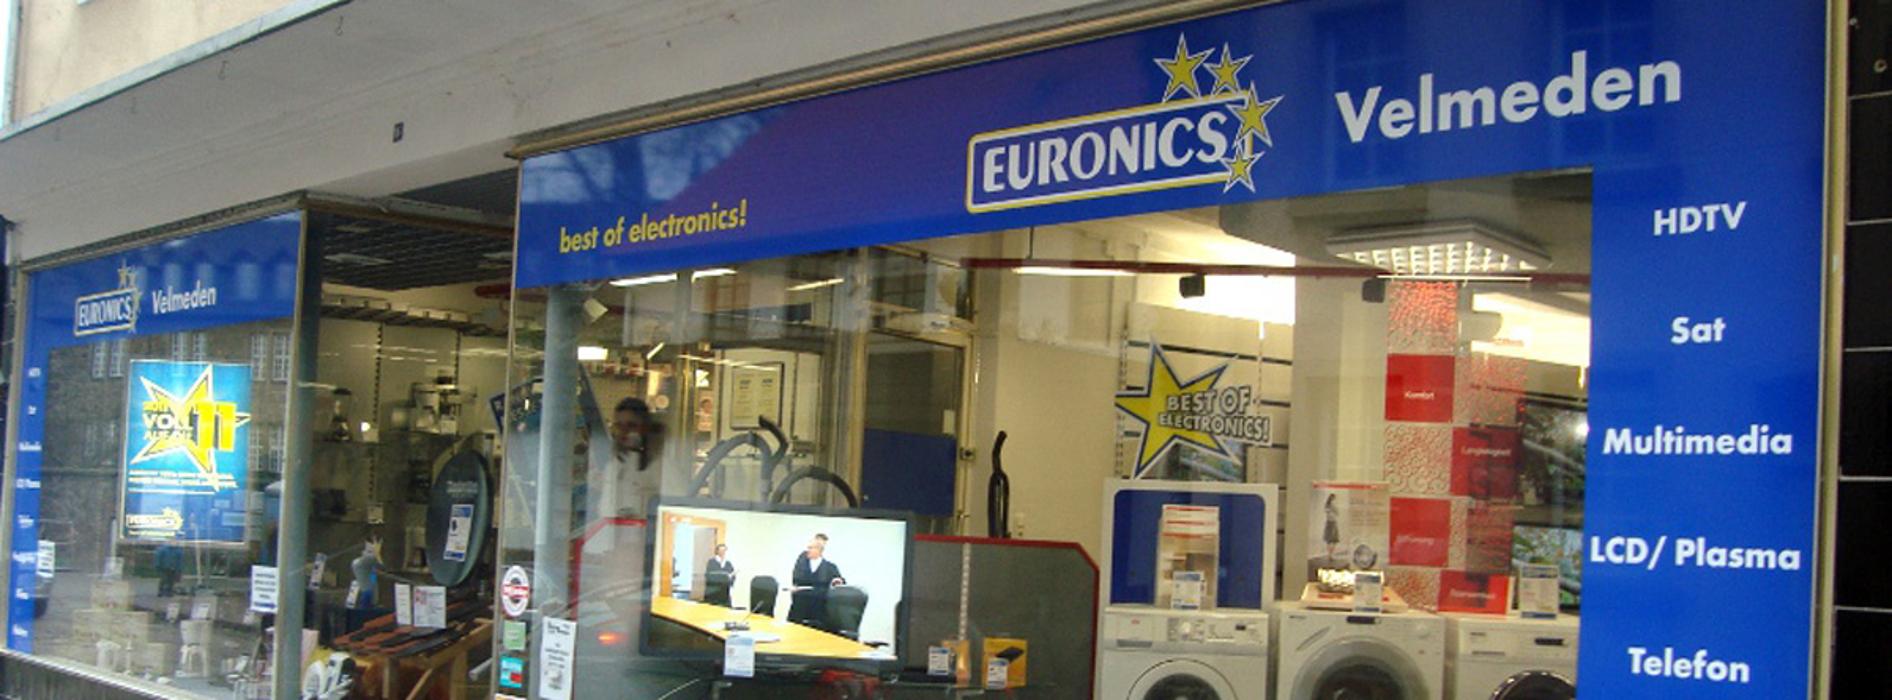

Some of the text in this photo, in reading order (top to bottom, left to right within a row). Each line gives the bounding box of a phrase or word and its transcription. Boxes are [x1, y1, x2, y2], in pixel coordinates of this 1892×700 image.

[1336, 50, 1682, 143] Velmeden
[983, 113, 1229, 192] EURONICS
[559, 198, 748, 254] best of electronics!
[1653, 202, 1747, 236] HDTV
[79, 297, 132, 327] EURONICS
[152, 280, 216, 314] Velmeden
[1671, 318, 1726, 344] Sat
[1166, 385, 1251, 415] BEST OF
[1159, 412, 1271, 442] ELECTRONICS!
[1603, 425, 1793, 456] Multimedia
[1590, 536, 1801, 570] LCD/ Plasma
[1628, 648, 1751, 683] Telefon
